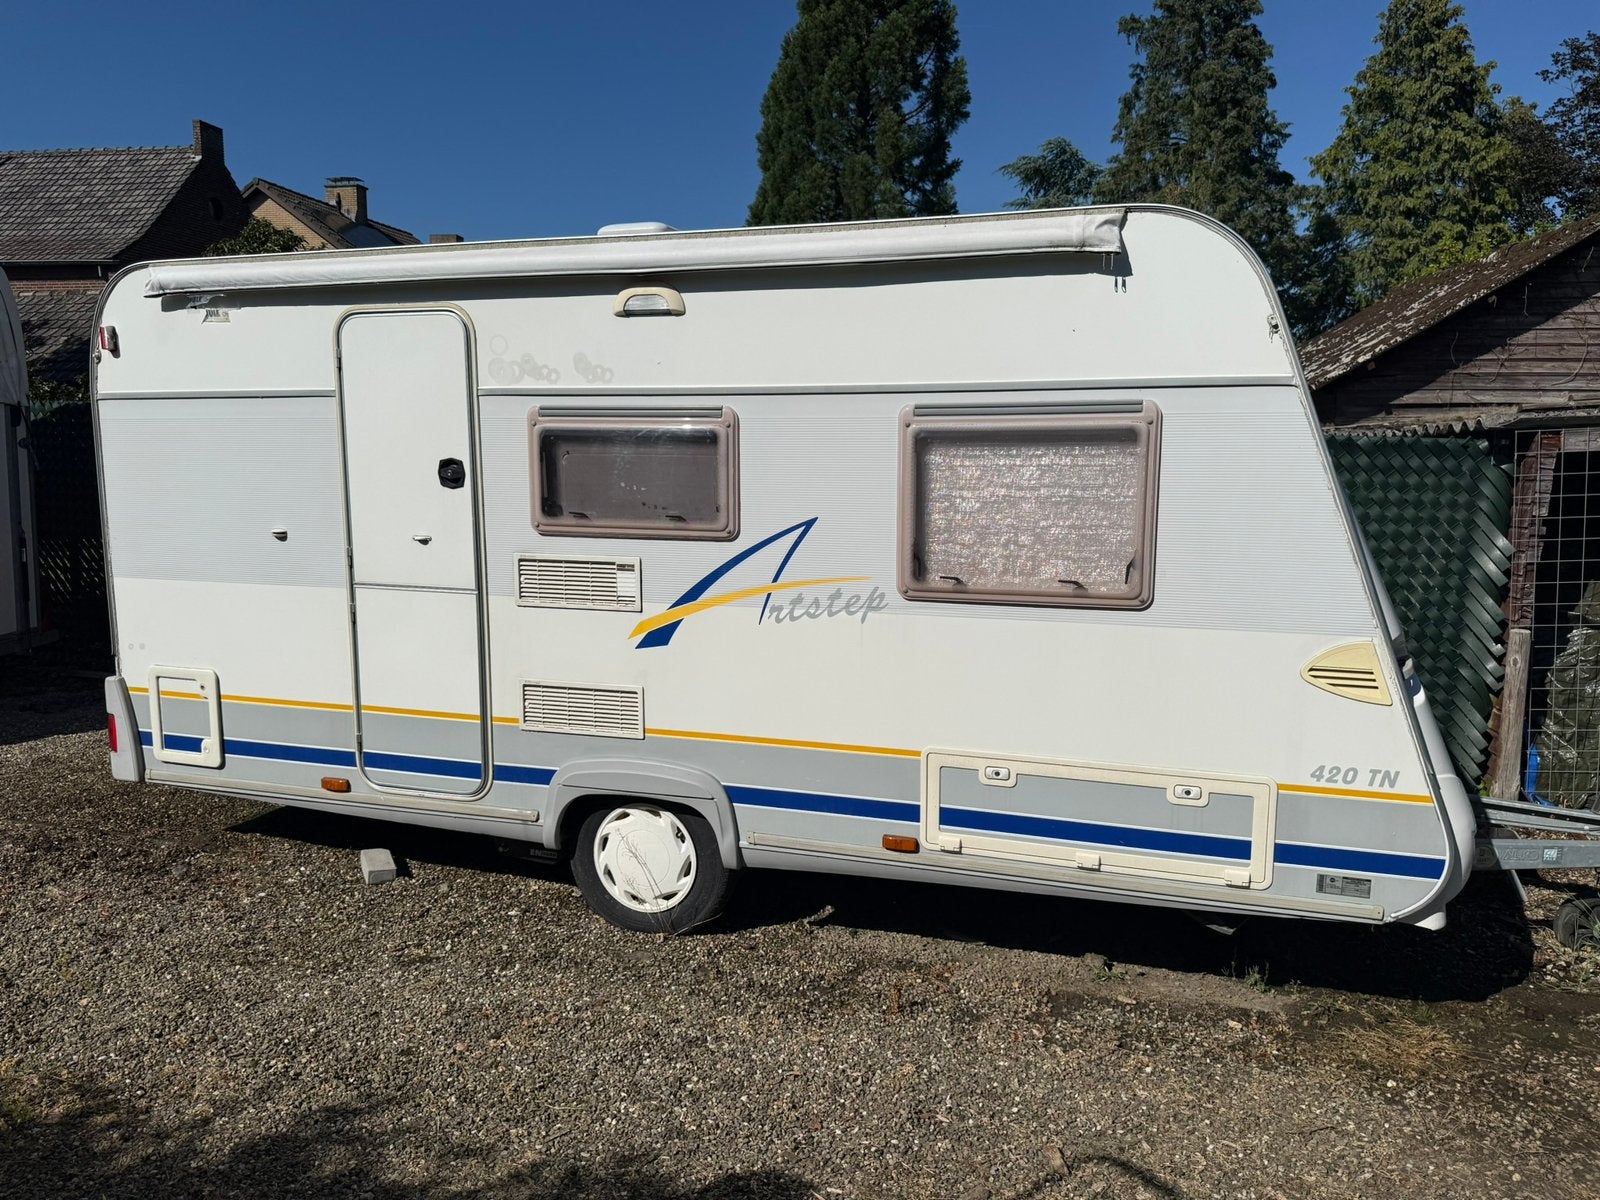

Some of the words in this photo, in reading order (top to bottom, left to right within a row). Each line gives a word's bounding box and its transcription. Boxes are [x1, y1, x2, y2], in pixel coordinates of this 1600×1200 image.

[627, 516, 889, 650] Artstep
[1310, 765, 1359, 785] 420
[1368, 768, 1400, 788] TN
